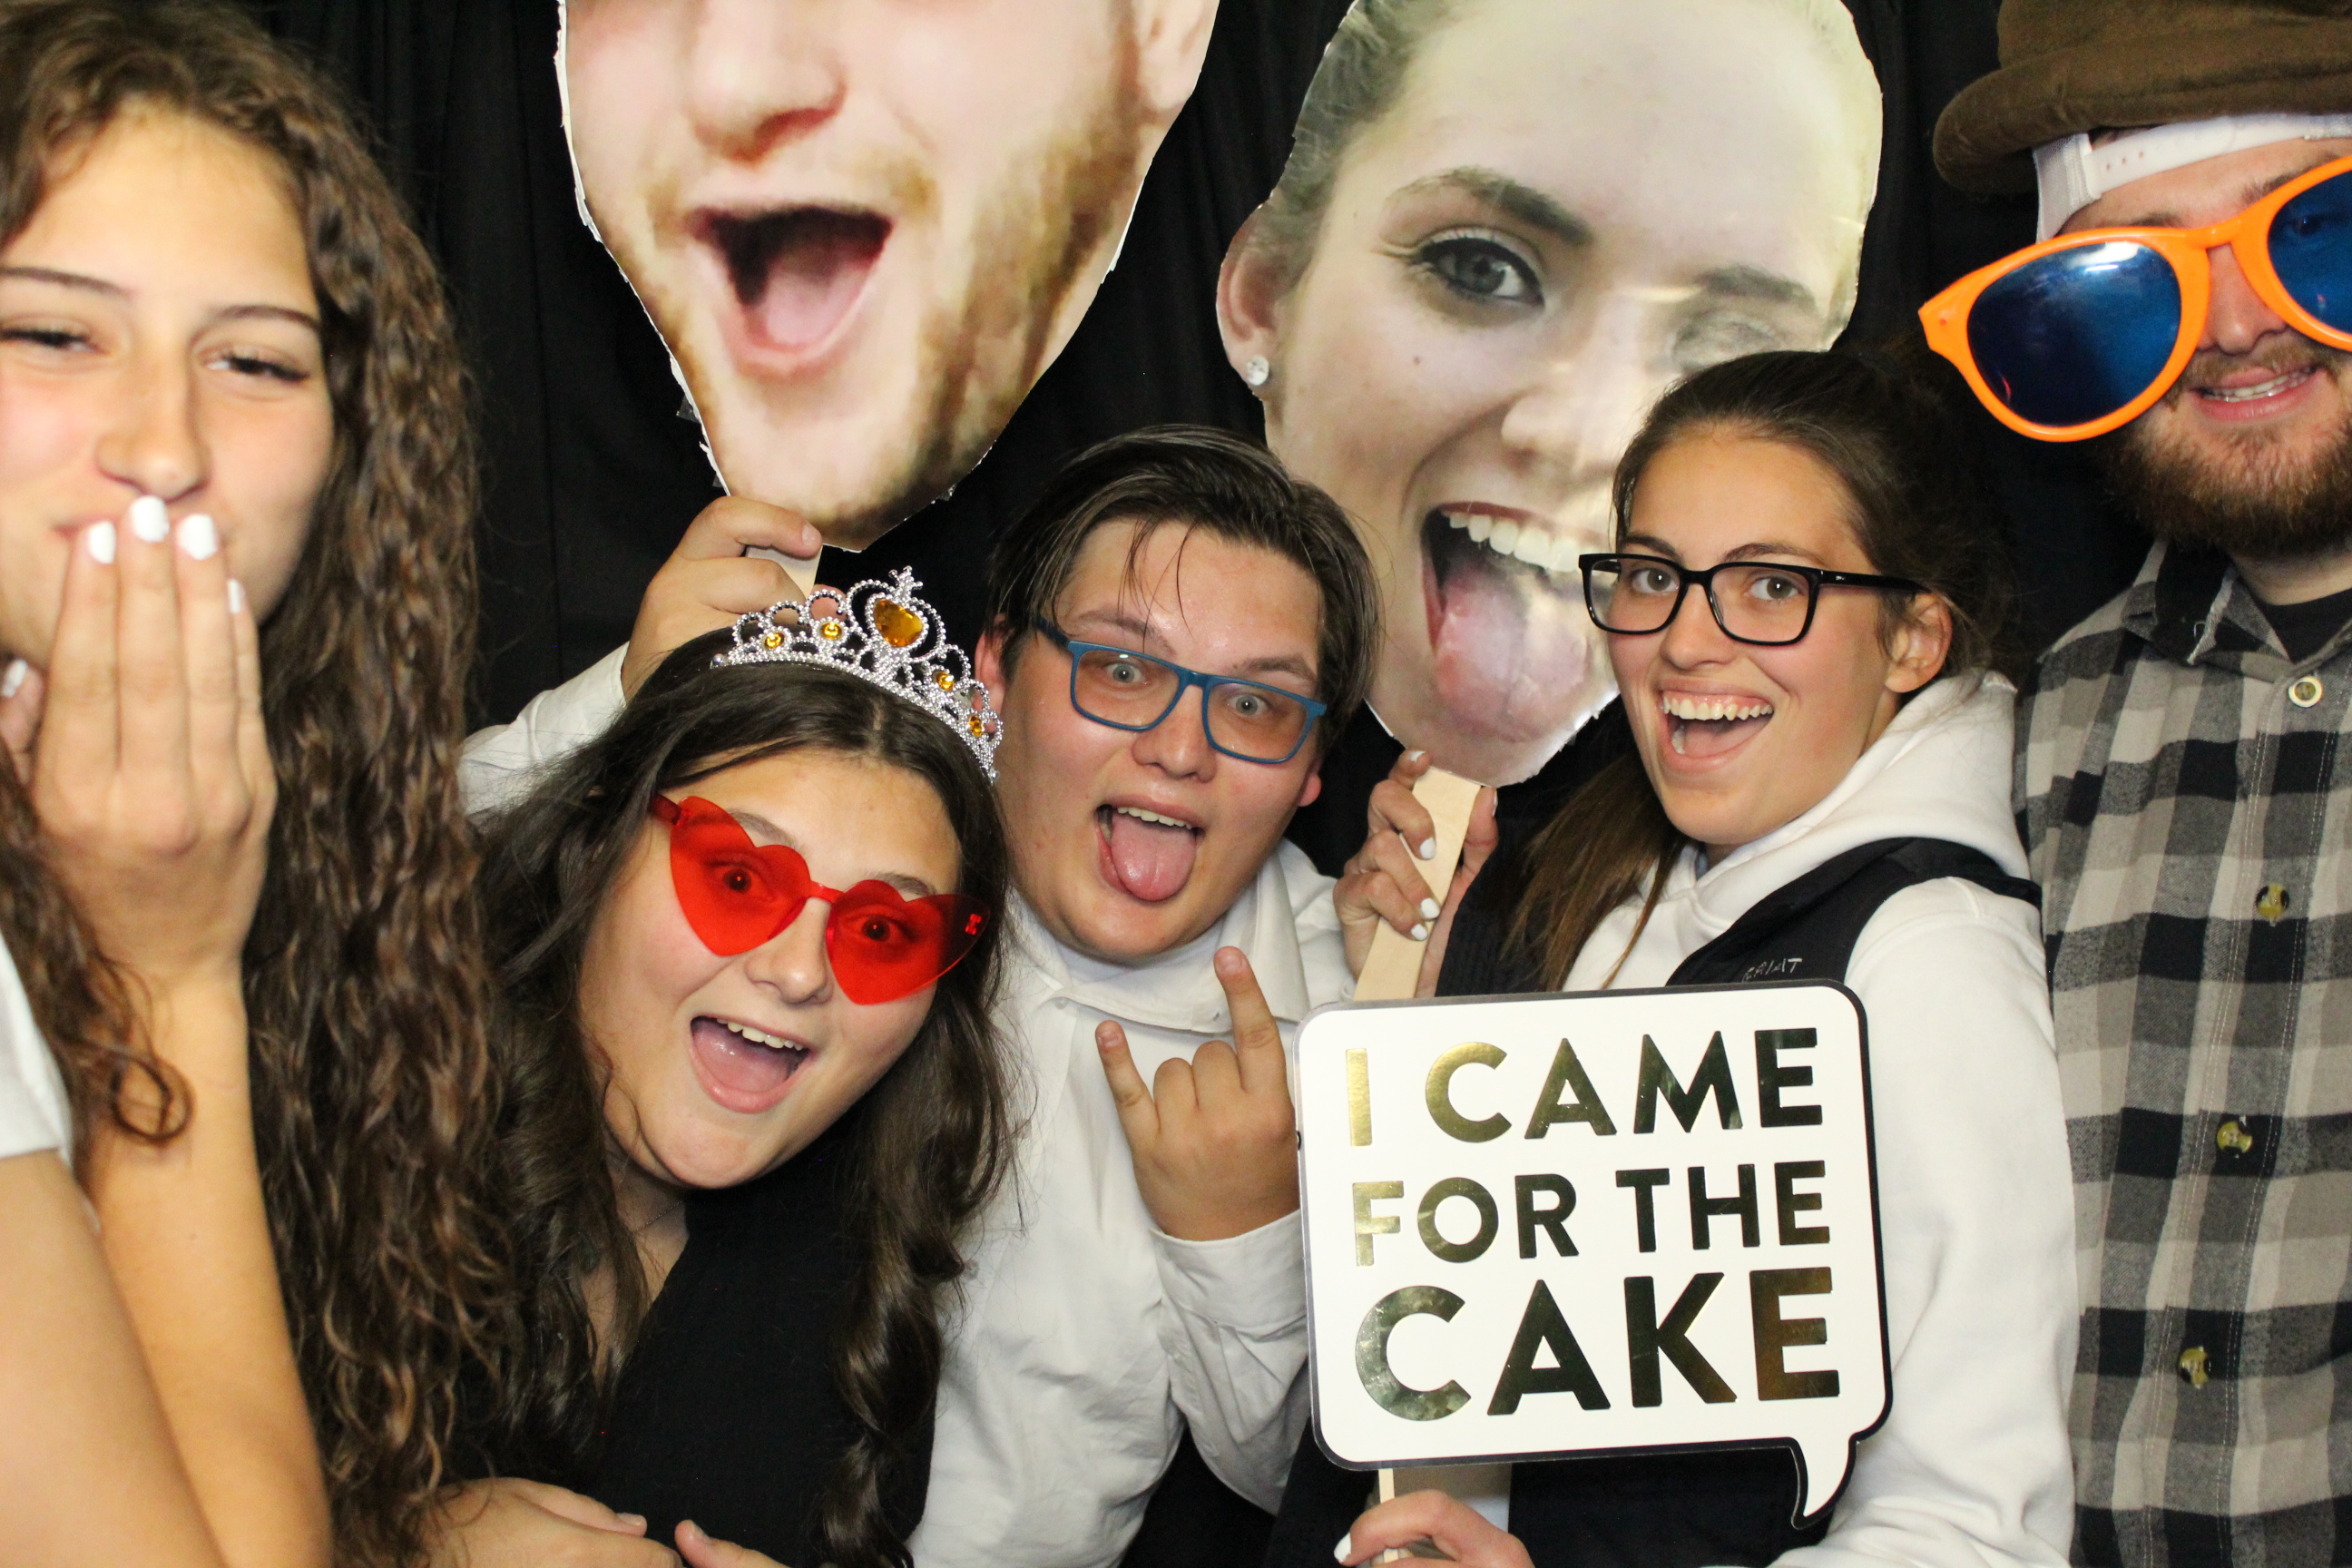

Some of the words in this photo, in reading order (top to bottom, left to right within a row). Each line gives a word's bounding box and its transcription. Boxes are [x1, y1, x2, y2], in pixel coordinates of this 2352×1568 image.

[1346, 1048, 1373, 1147] I
[1425, 1026, 1824, 1143] CAME
[1352, 1172, 1580, 1267] FOR
[1614, 1160, 1831, 1254] THE
[1355, 1266, 1841, 1422] CAKE
